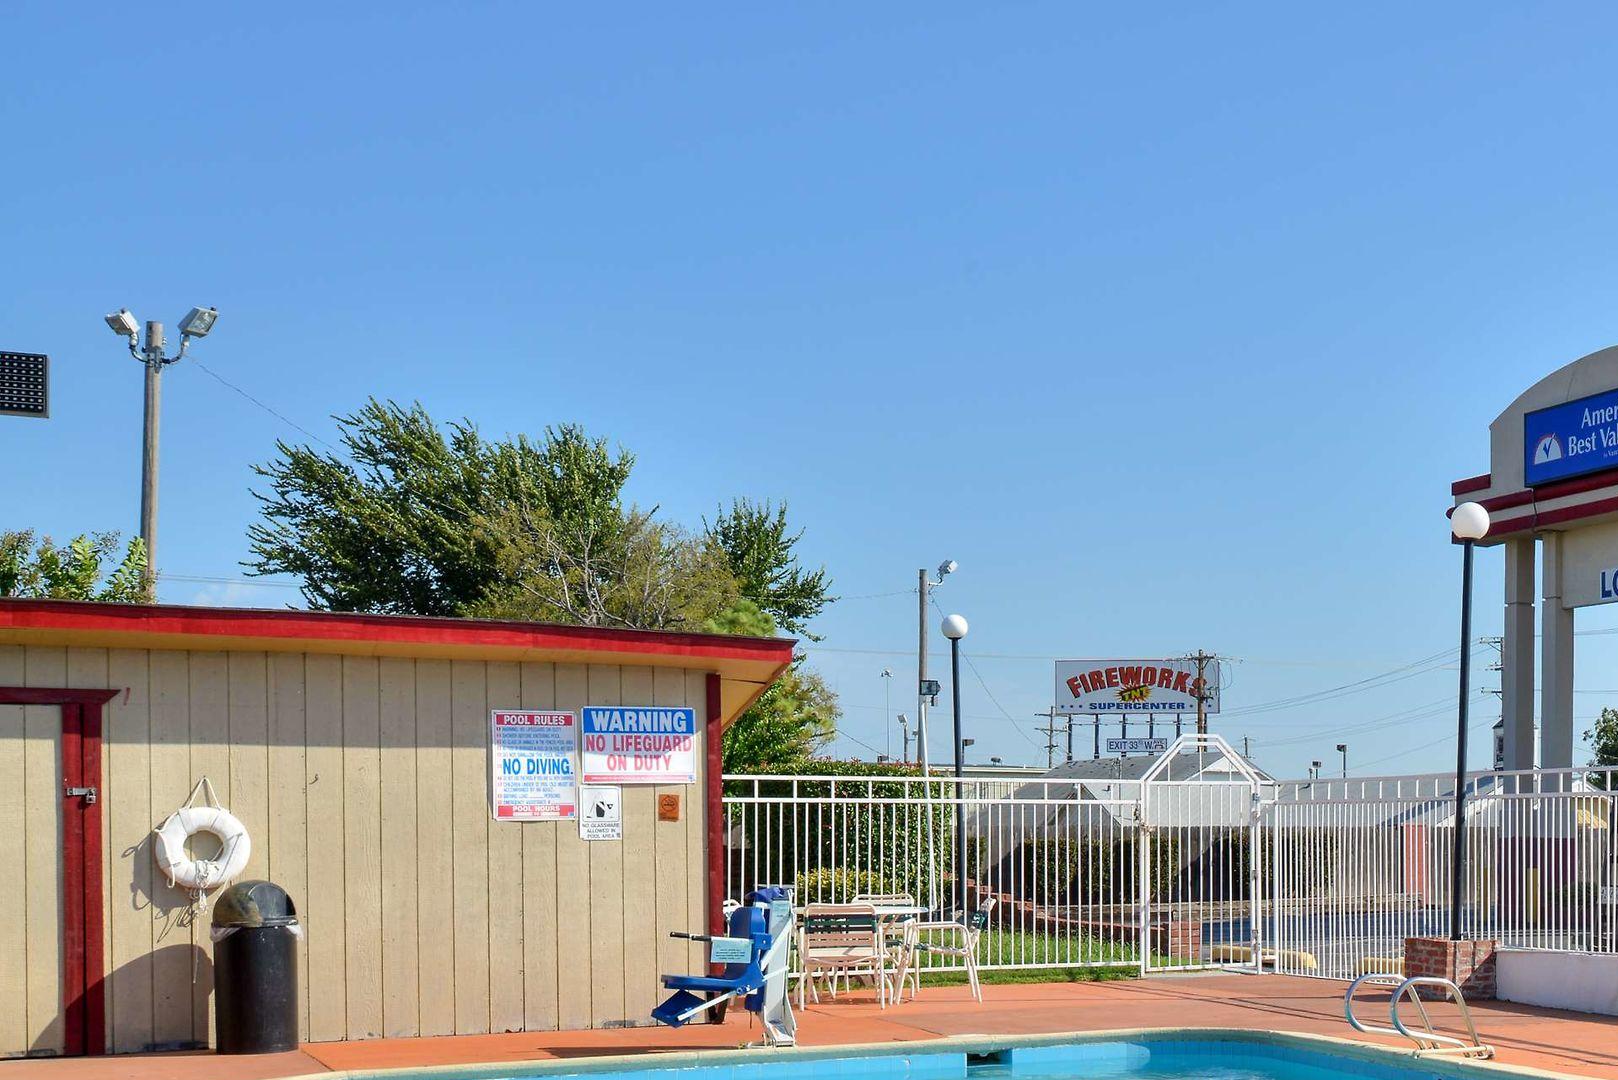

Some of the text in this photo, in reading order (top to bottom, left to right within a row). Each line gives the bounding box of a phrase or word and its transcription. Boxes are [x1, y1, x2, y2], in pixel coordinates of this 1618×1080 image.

[1568, 432, 1597, 457] Best
[1066, 666, 1208, 699] FIREWORKS
[1089, 702, 1186, 710] SUPERCENTER
[503, 714, 565, 726] POOL RULES
[590, 710, 687, 732] WARNING
[585, 734, 692, 752] NO LIFEGUARD
[1109, 741, 1128, 750] EXIT
[502, 758, 574, 775] NO DIVING.
[606, 754, 672, 771] ON DUTY
